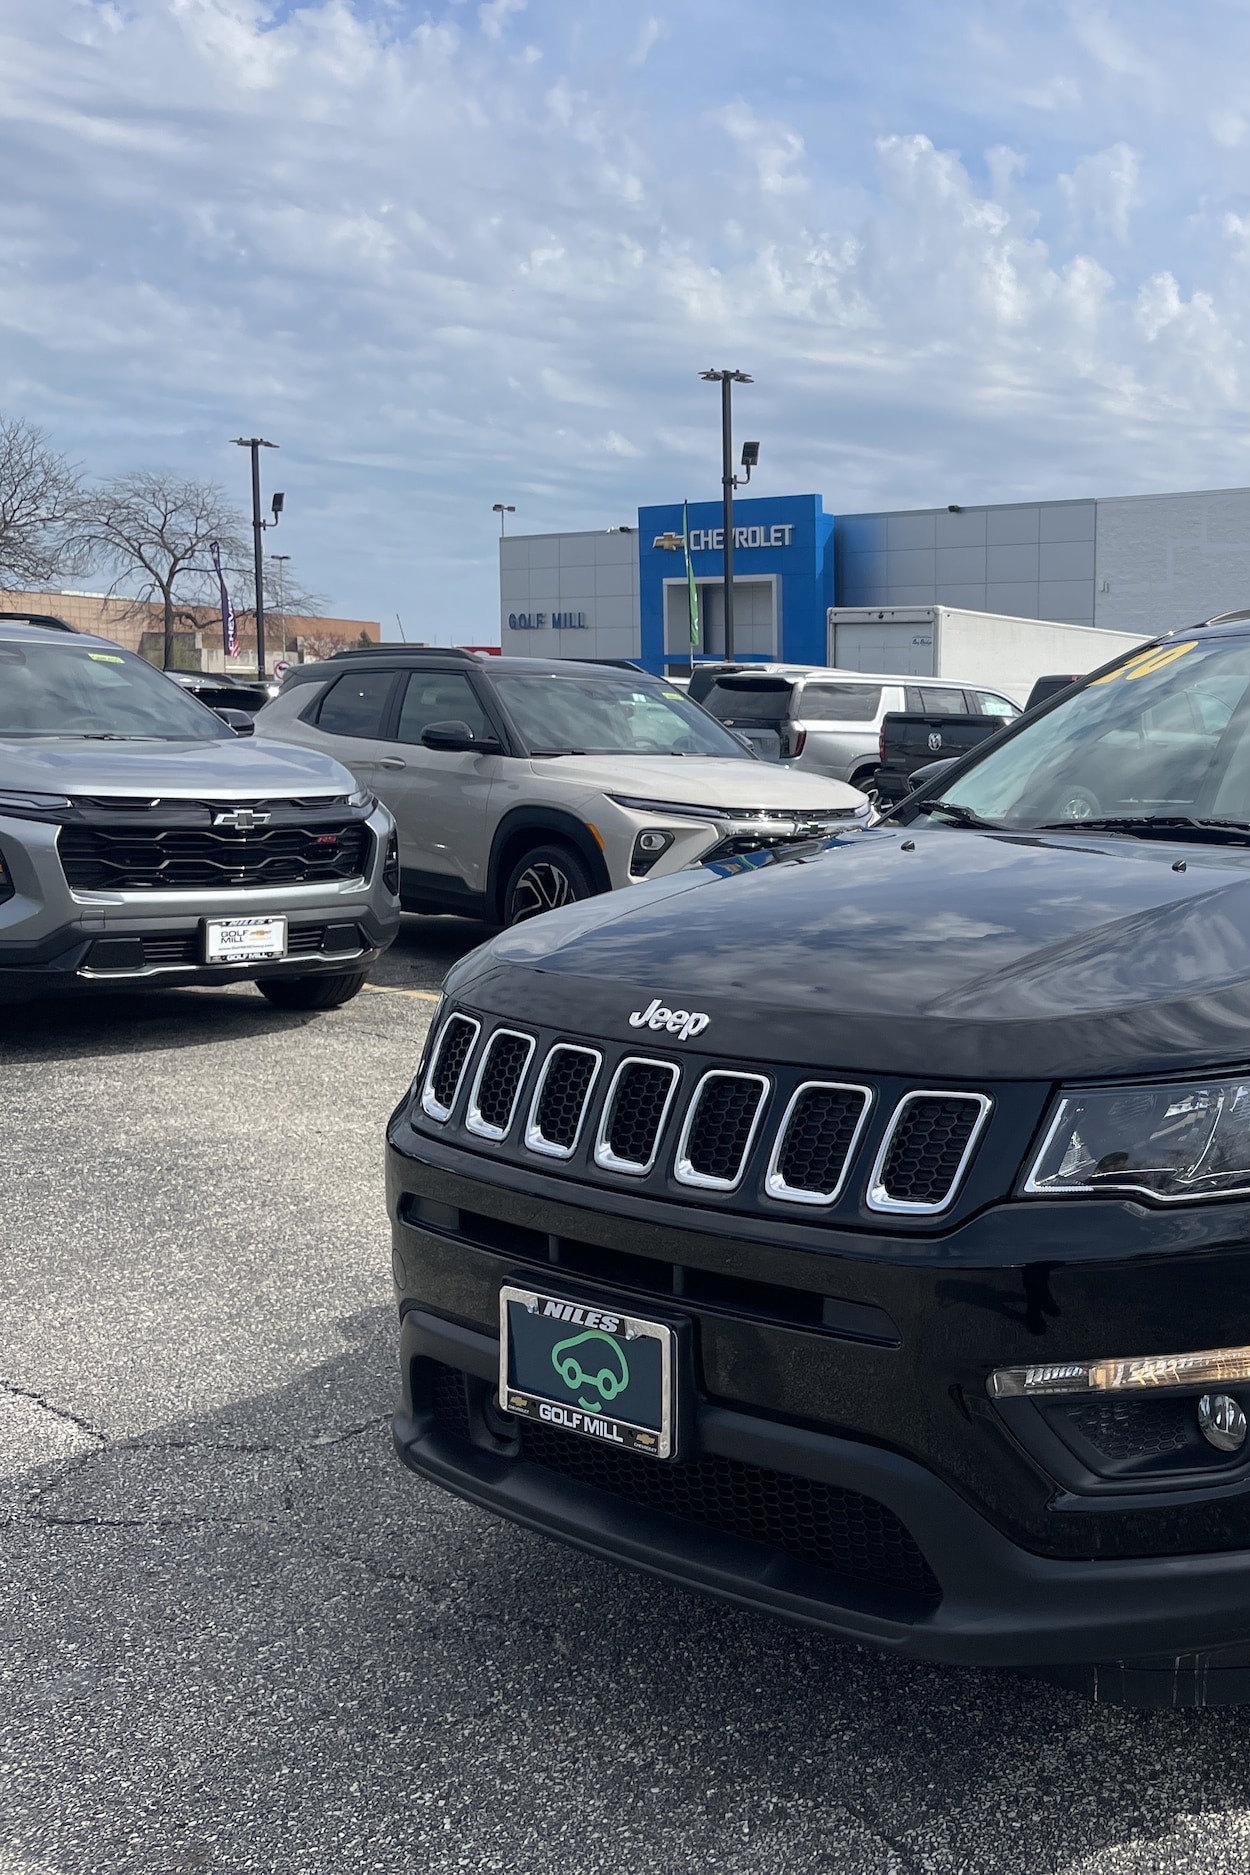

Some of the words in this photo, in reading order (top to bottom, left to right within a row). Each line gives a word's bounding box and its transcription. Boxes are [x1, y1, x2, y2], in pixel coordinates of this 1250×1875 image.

[689, 524, 794, 551] CHEROLET
[508, 612, 546, 630] GOLF
[551, 611, 587, 629] MILL
[221, 929, 249, 938] GOLF
[629, 999, 709, 1041] Jeep
[543, 1301, 620, 1333] NILES
[539, 1403, 582, 1429] GOLF
[583, 1417, 624, 1443] MILL
